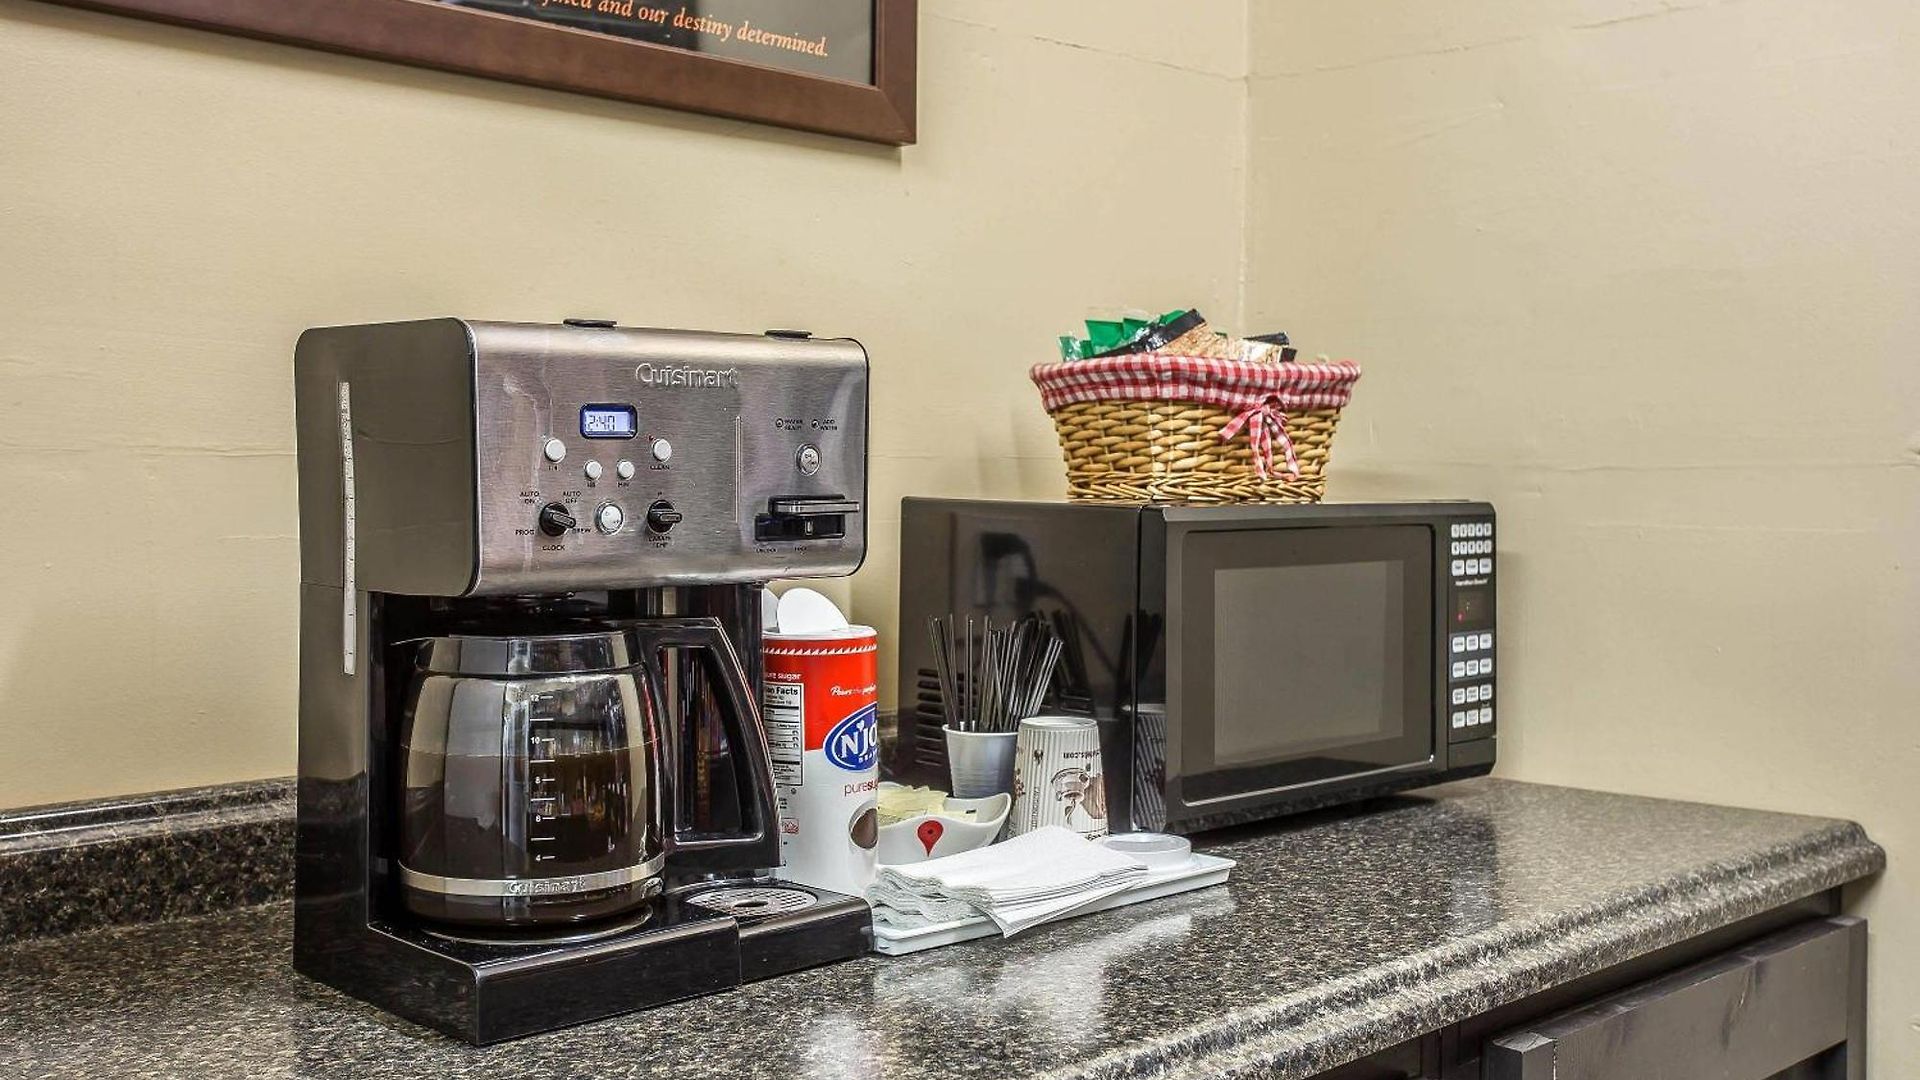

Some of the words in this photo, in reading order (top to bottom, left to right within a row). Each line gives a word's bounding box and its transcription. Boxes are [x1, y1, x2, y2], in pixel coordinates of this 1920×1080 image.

[598, 0, 632, 17] and
[638, 6, 669, 24] our
[673, 6, 732, 42] destiny
[736, 20, 828, 58] determined.
[635, 362, 738, 388] Cuisinart
[777, 672, 802, 682] sugar
[776, 687, 799, 696] Facts
[530, 694, 540, 702] 12
[530, 737, 540, 745] 10
[509, 876, 586, 895] Cuisinart
